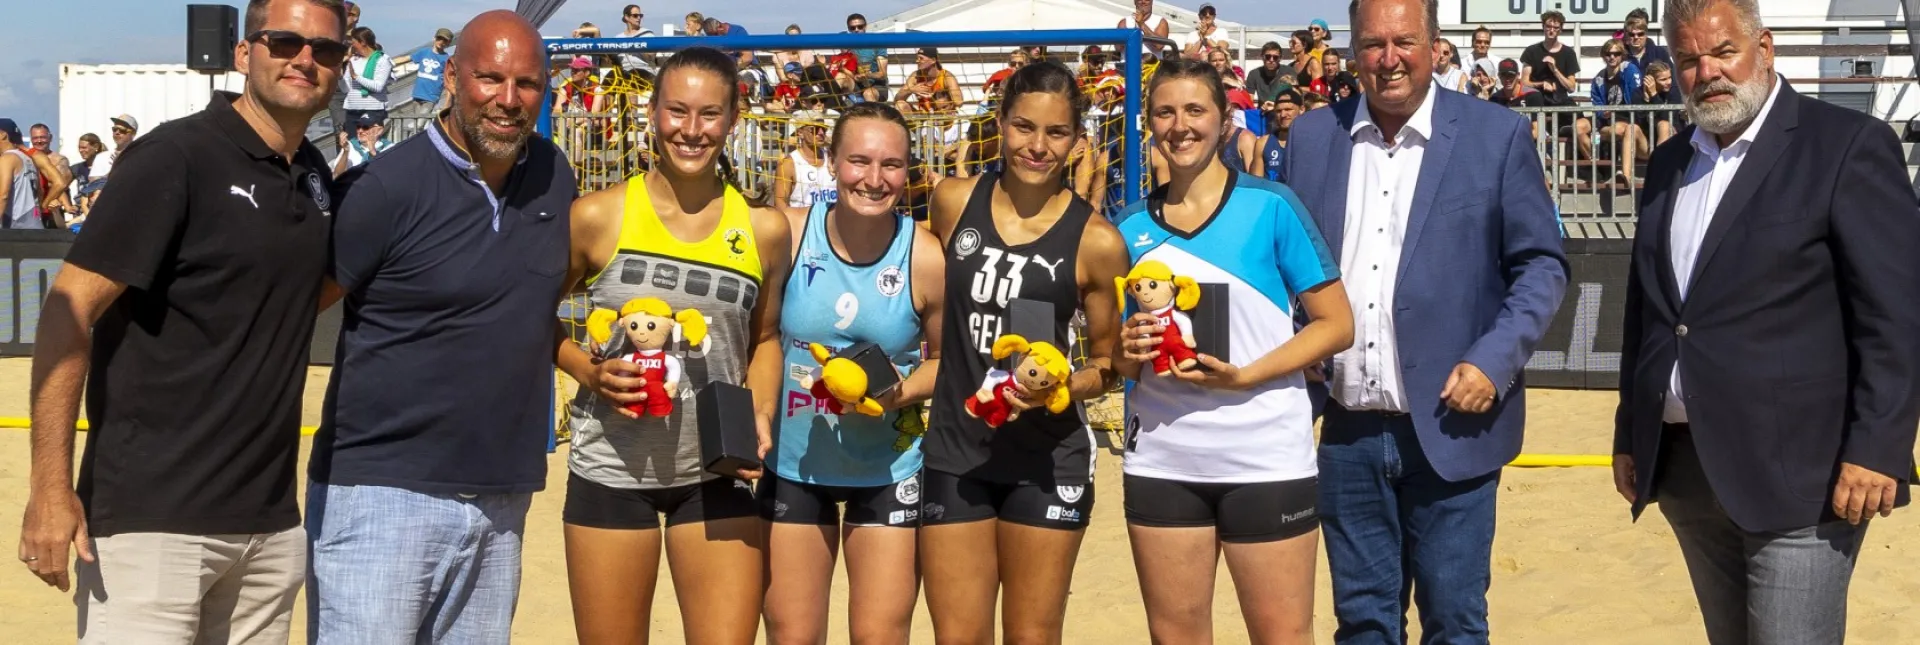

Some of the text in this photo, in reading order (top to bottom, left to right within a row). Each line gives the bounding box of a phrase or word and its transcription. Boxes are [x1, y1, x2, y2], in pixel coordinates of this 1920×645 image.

[1271, 150, 1279, 160] 9
[971, 246, 1028, 309] 33
[834, 292, 859, 330] 9
[635, 358, 662, 370] CUXI
